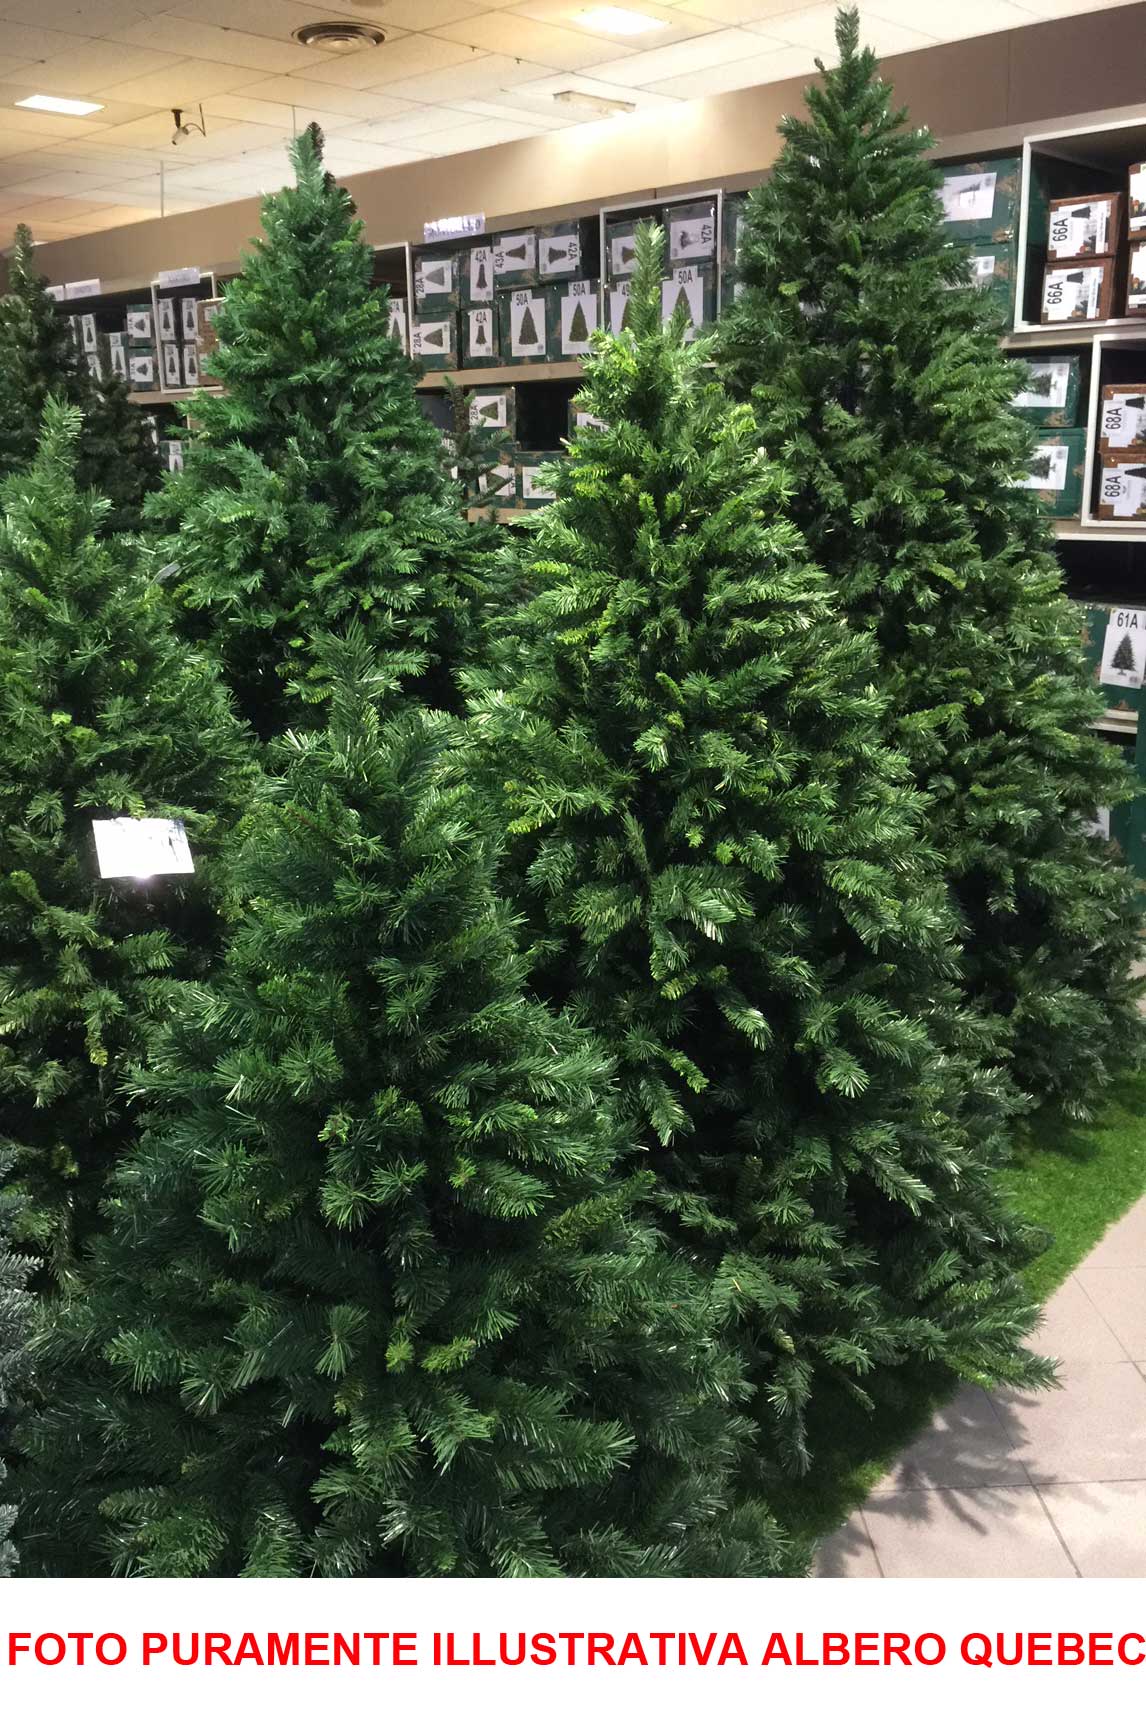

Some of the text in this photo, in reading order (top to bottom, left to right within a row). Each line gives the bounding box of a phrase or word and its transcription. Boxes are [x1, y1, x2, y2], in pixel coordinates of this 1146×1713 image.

[702, 224, 712, 244] 42A
[1053, 218, 1068, 242] 66A
[568, 242, 577, 260] 42A
[678, 269, 693, 285] 50A
[516, 292, 528, 306] 50A
[573, 283, 586, 297] 50A
[1047, 281, 1063, 305] 66A
[475, 311, 488, 323] 42A
[1105, 407, 1122, 430] 68A
[1104, 475, 1121, 498] 68A
[1117, 611, 1138, 629] 61A
